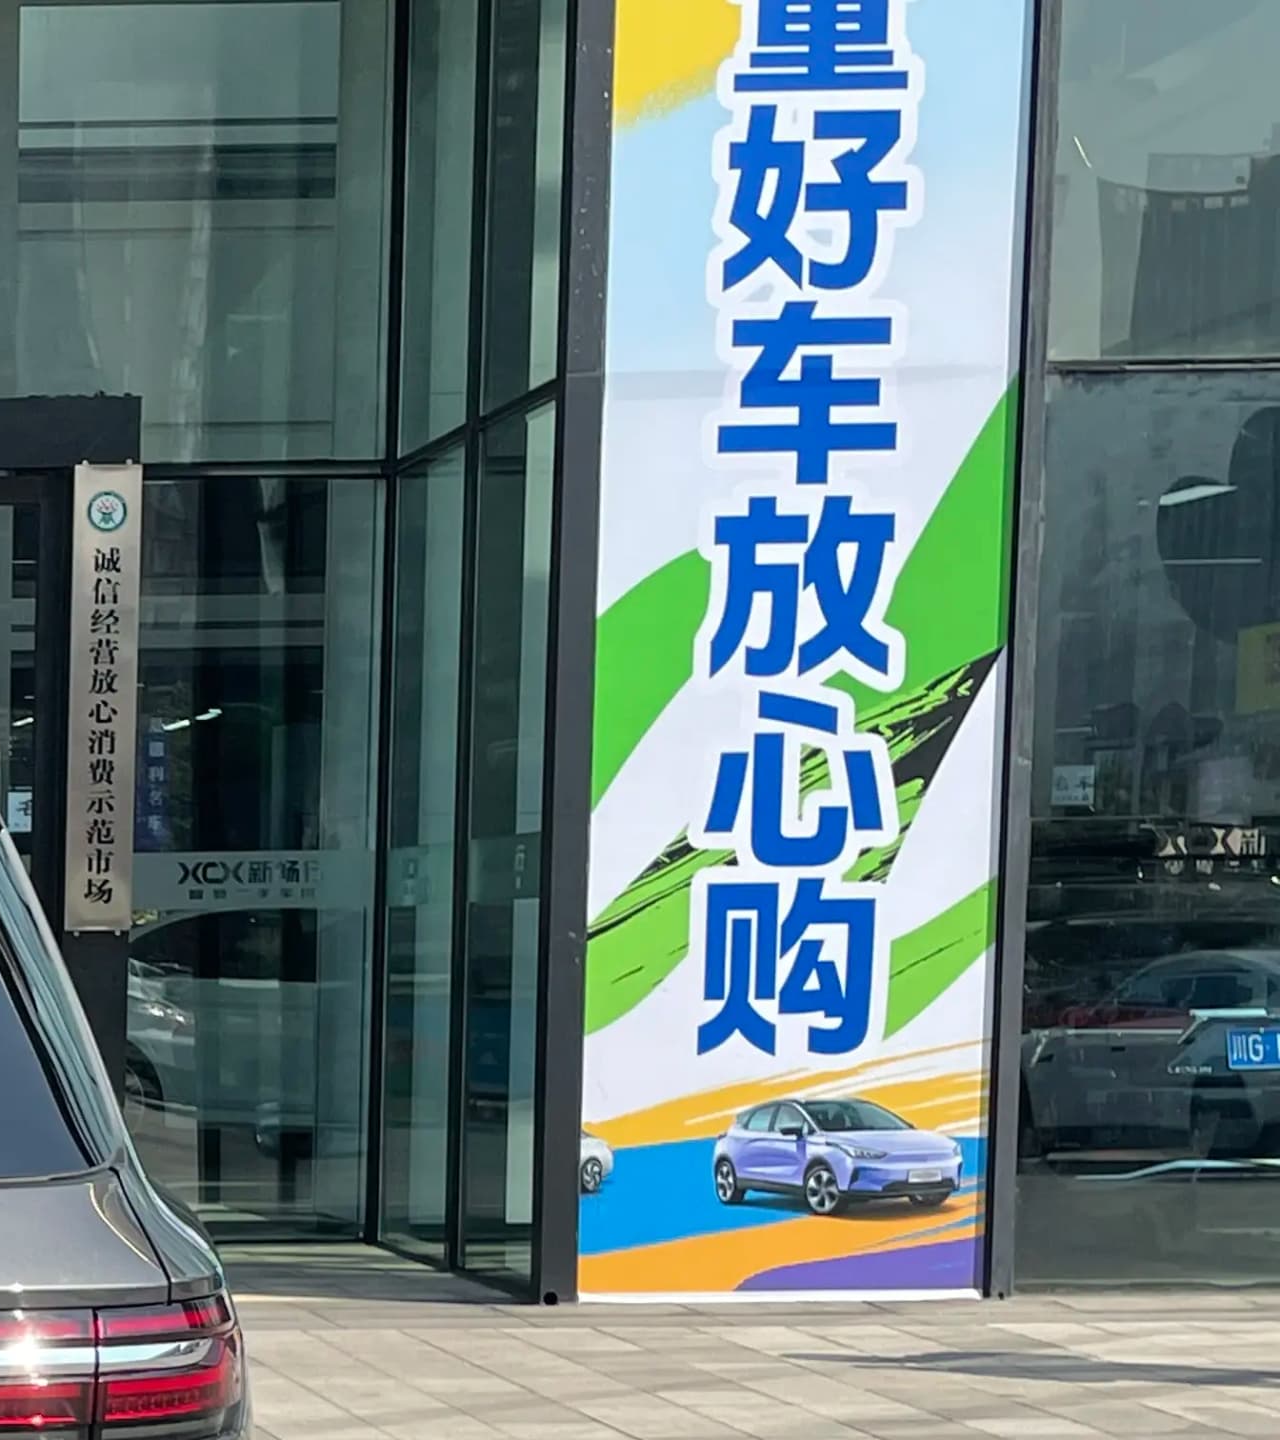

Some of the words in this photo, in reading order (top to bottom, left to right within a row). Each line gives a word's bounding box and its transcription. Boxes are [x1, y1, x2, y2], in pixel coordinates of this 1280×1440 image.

[82, 546, 123, 906] 诚信经营放心消费示范市场
